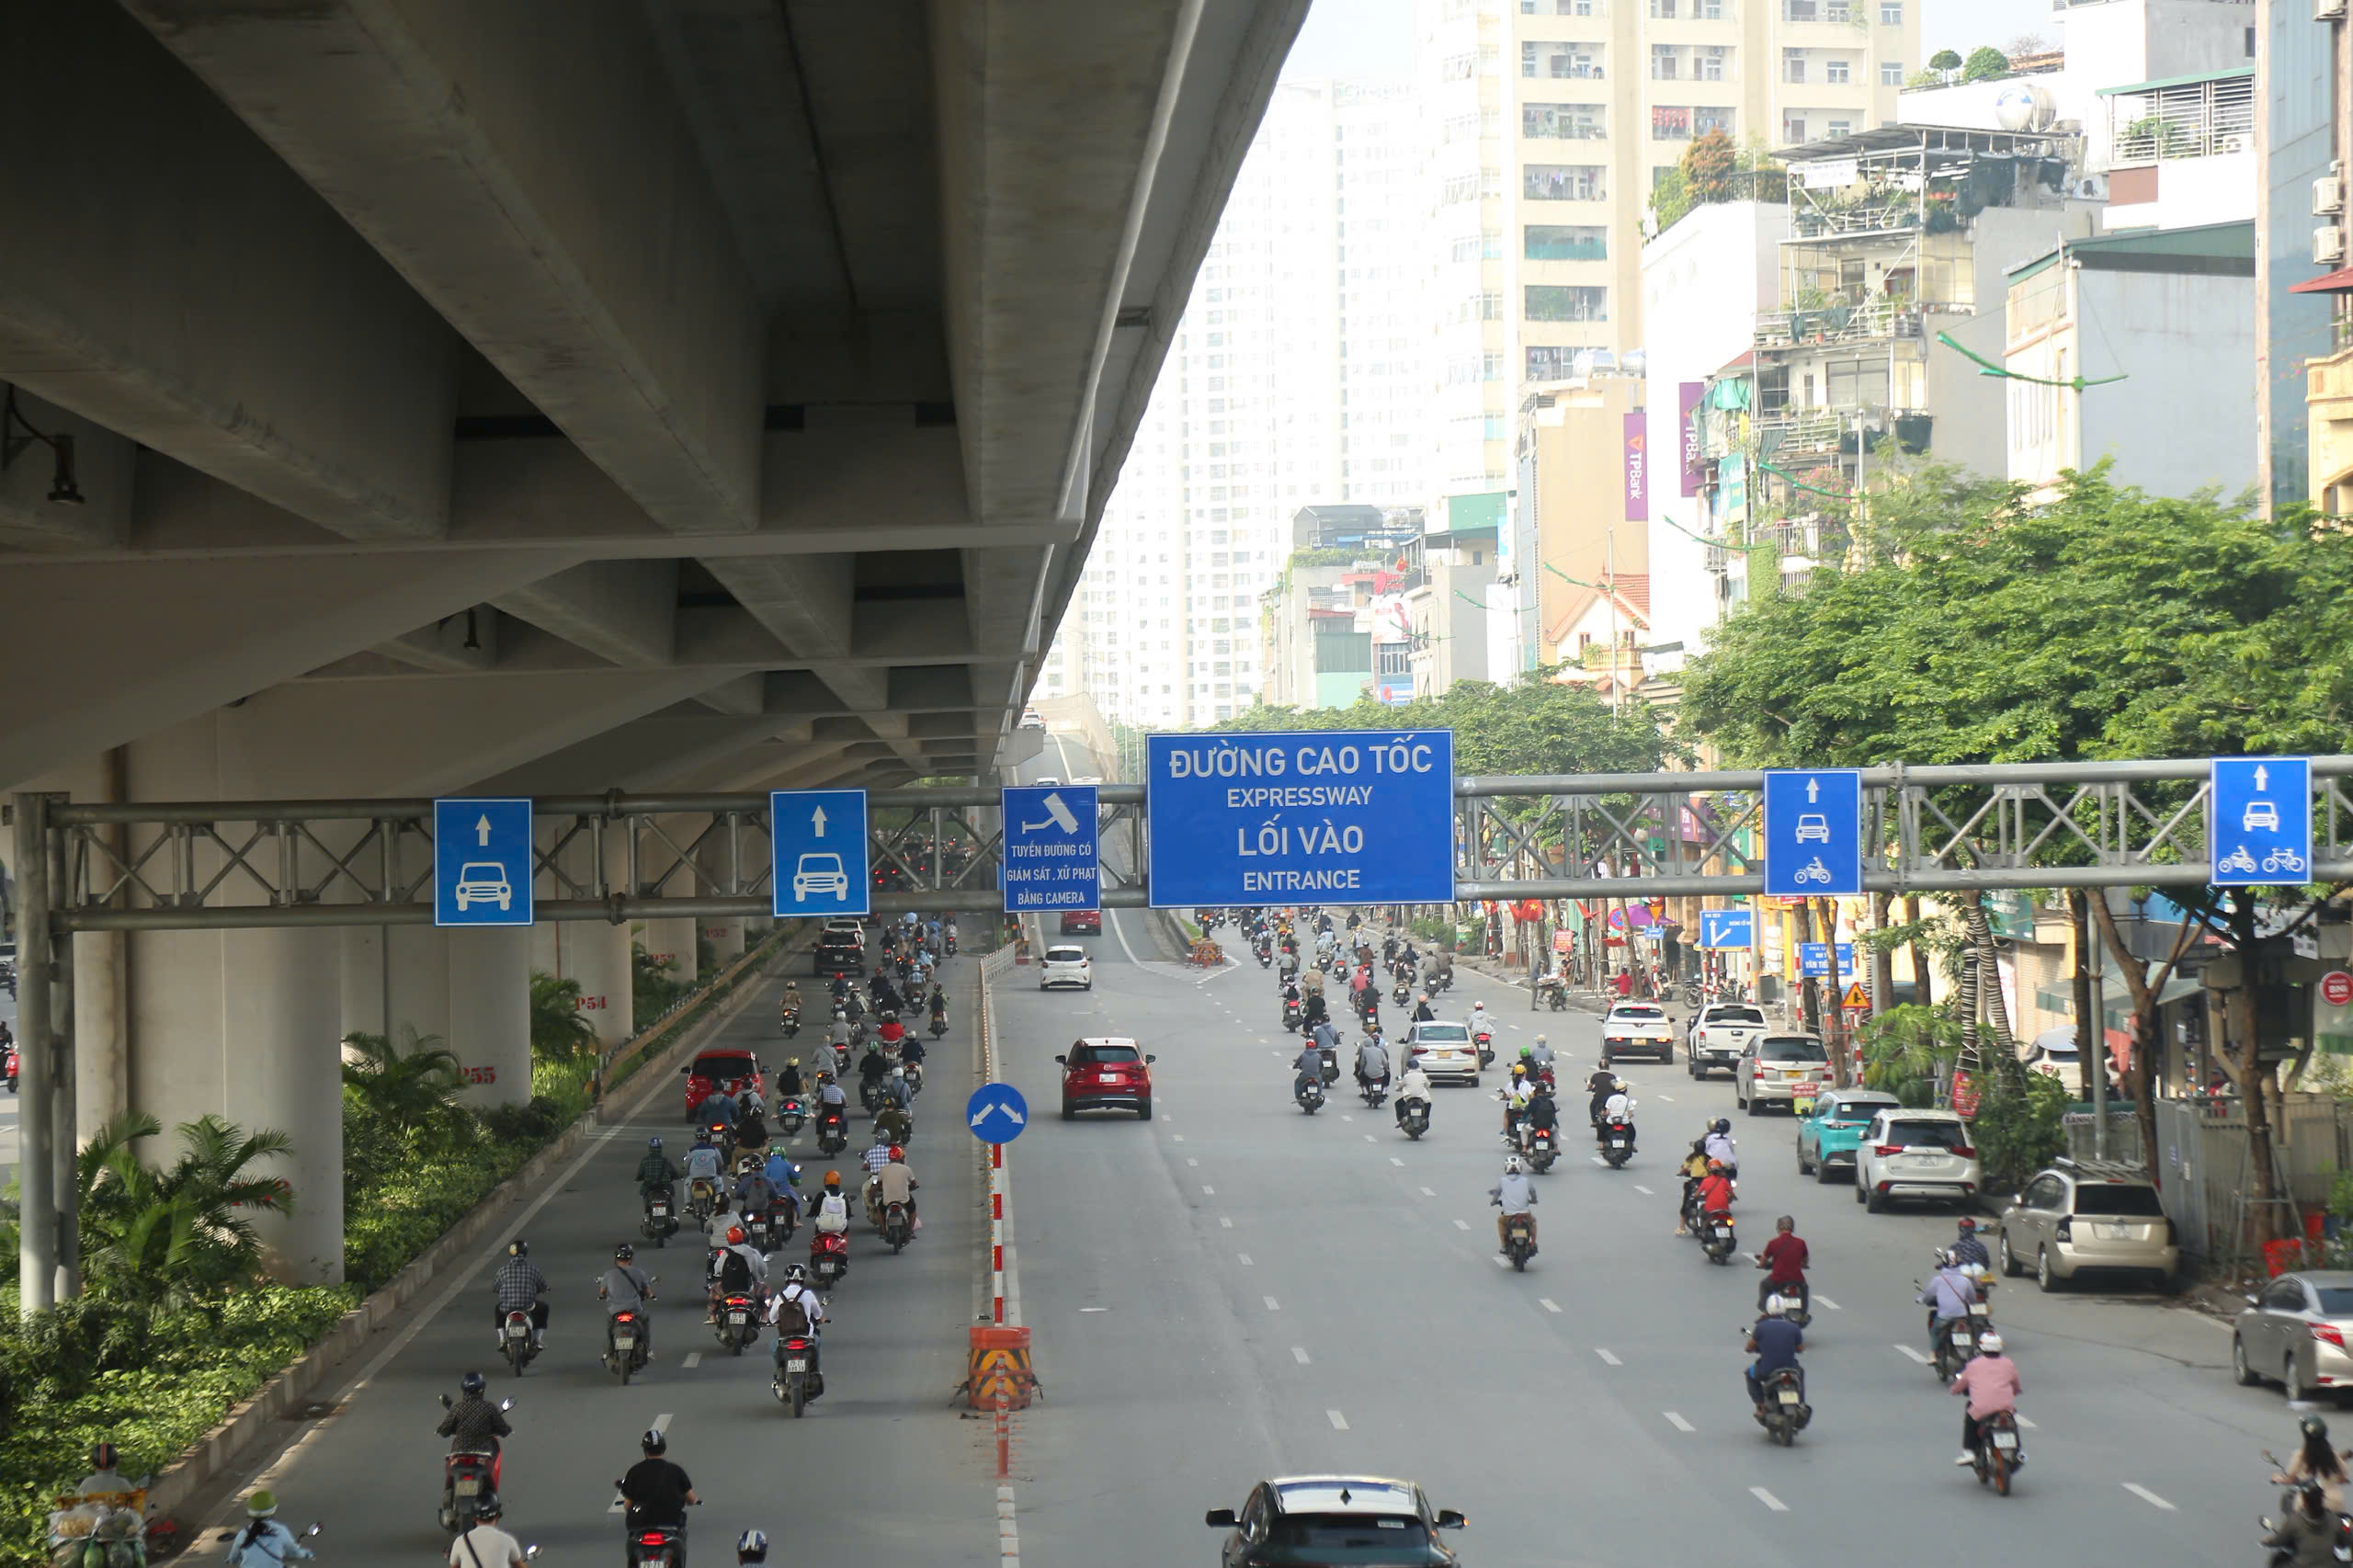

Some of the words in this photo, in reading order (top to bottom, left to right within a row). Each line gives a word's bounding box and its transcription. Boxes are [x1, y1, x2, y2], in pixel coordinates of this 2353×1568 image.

[1629, 451, 1643, 500] TPBank
[1168, 739, 1286, 778] ĐƯỜNG
[1296, 745, 1359, 776] CAO
[1368, 734, 1433, 774] TỐC
[1226, 786, 1373, 808] EXPRESSWAY
[1238, 813, 1288, 857] LỐI
[1297, 818, 1364, 855] VÀO
[1011, 840, 1041, 858] TUYẾN
[1044, 841, 1076, 857] ĐƯỜNG
[1078, 841, 1092, 856] CÓ
[1006, 866, 1031, 881] GIÁM
[1072, 868, 1097, 881] PHẠT
[1243, 869, 1360, 892] ENTRANCE
[1017, 888, 1043, 904] BẰNG
[1045, 892, 1085, 904] CAMERA
[574, 995, 608, 1010] P54
